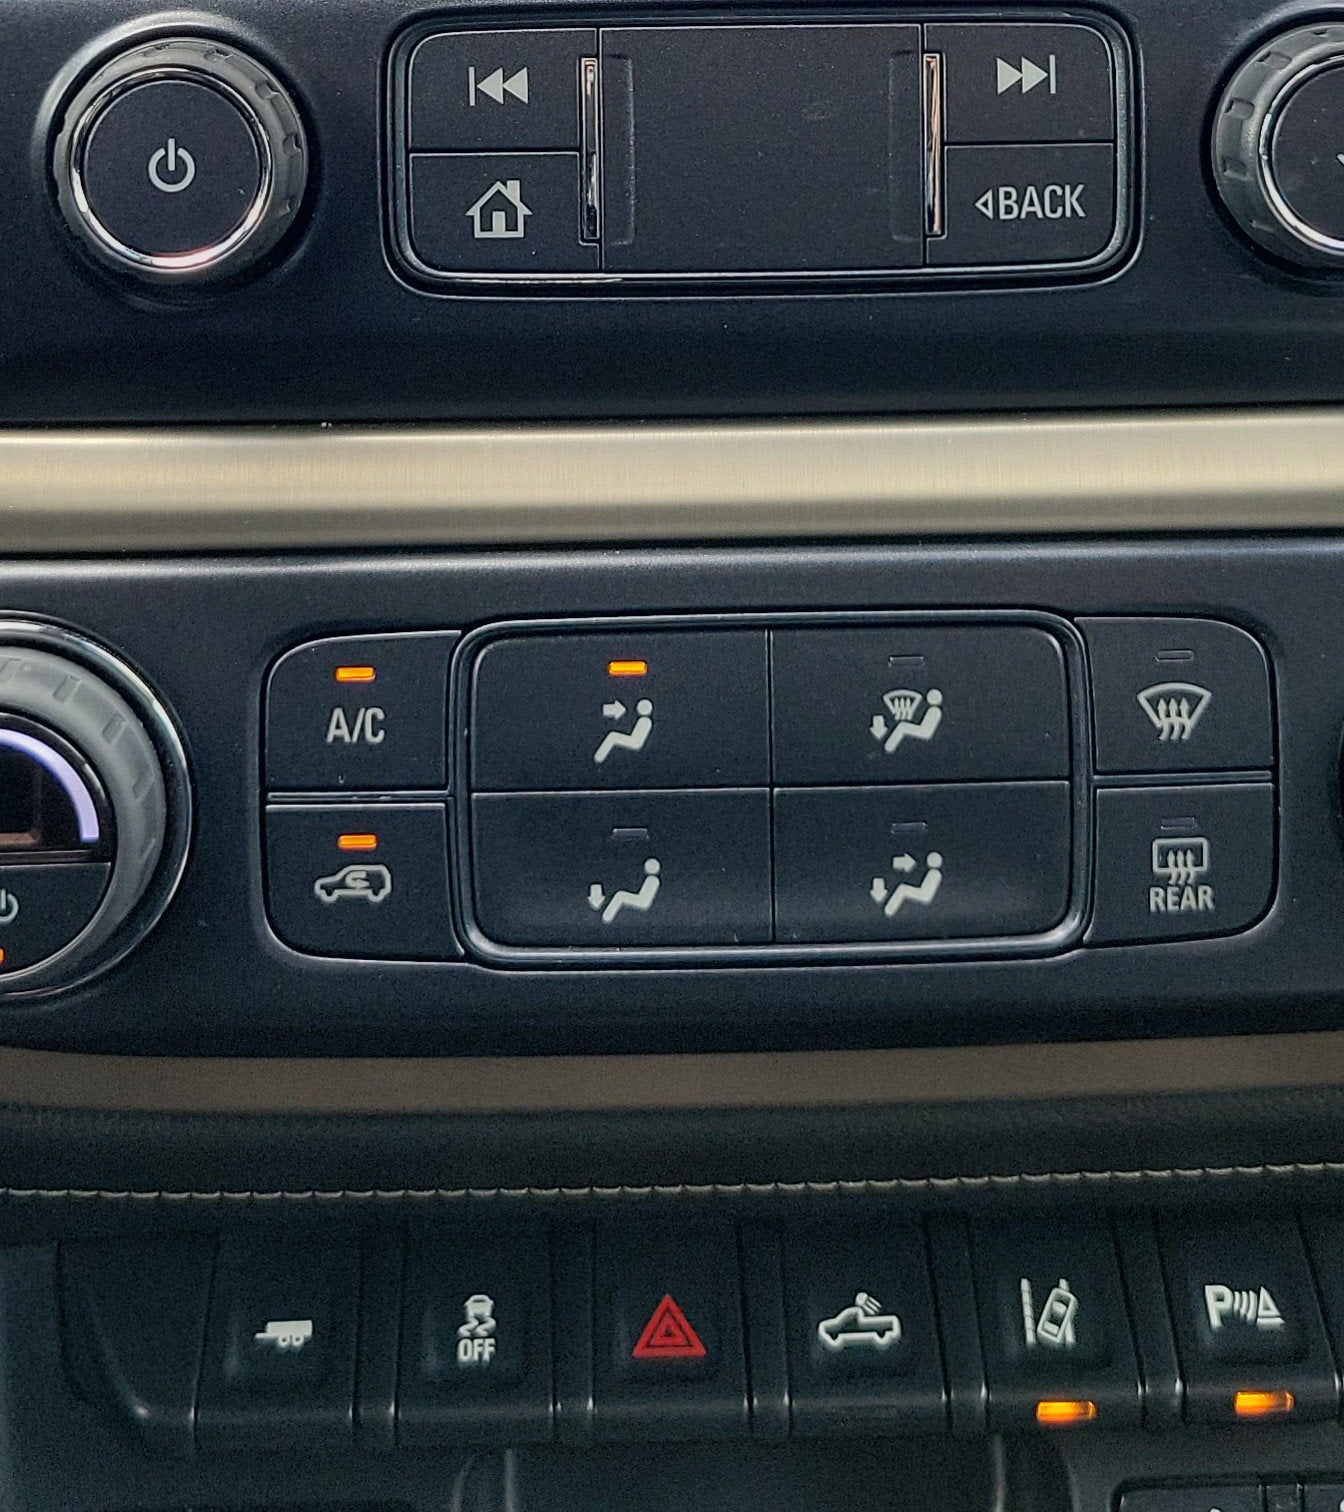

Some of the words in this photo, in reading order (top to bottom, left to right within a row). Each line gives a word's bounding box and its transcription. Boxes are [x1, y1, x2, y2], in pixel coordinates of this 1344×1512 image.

[998, 184, 1086, 220] BACK
[326, 707, 386, 744] A/C
[1149, 884, 1215, 912] REAR
[457, 1337, 496, 1364] OFF
